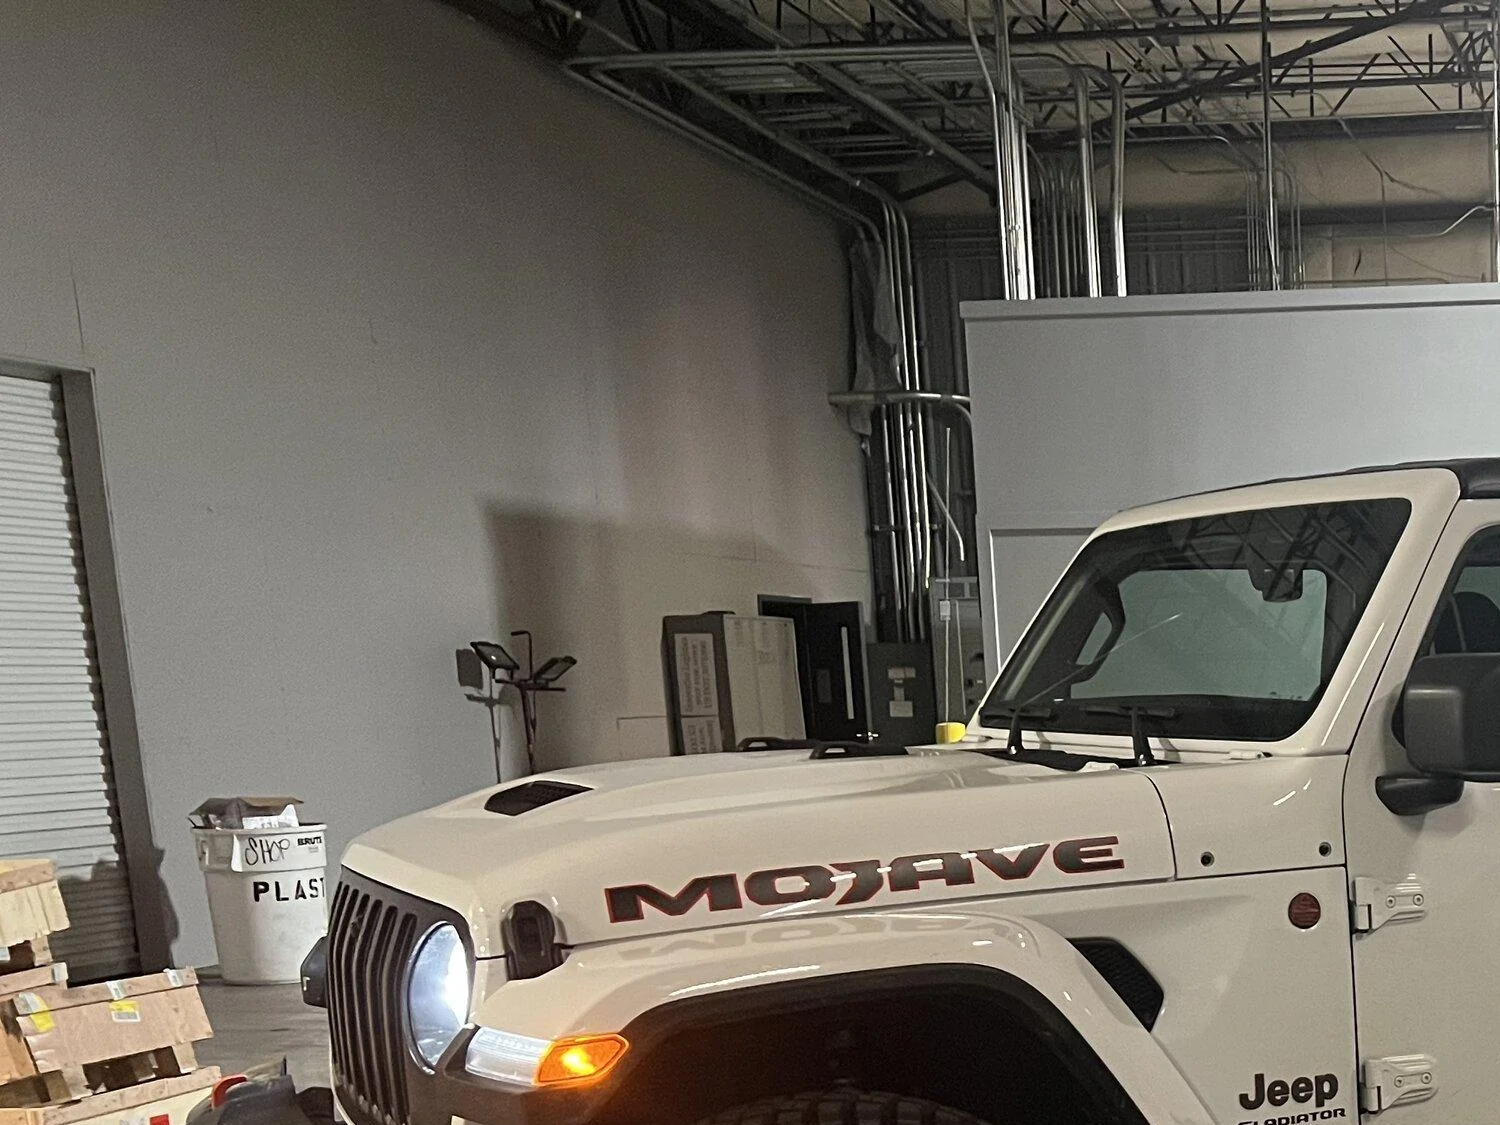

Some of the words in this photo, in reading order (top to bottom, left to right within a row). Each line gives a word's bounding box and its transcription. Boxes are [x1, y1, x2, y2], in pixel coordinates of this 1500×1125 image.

[244, 837, 290, 866] SHOP
[603, 835, 1125, 924] MOJAVE
[1238, 1073, 1339, 1110] Jeep
